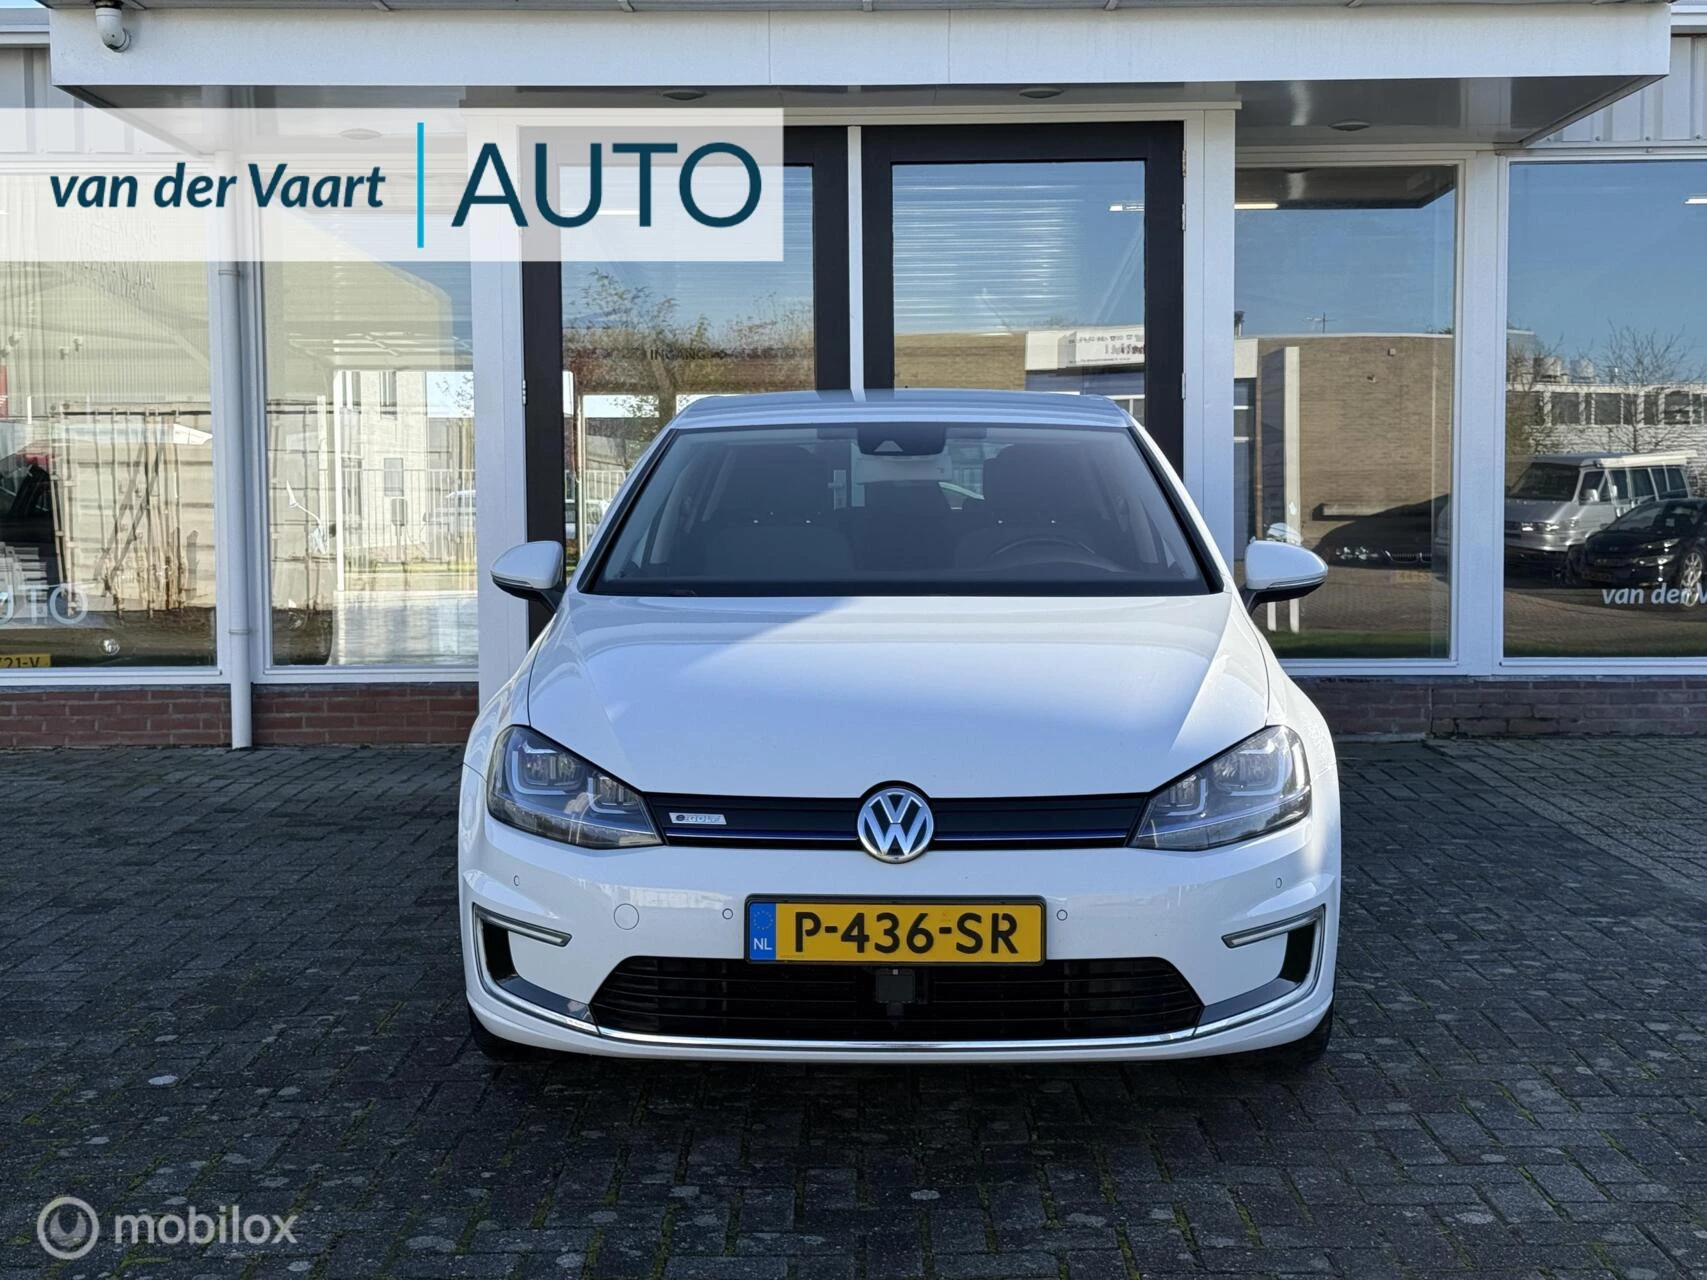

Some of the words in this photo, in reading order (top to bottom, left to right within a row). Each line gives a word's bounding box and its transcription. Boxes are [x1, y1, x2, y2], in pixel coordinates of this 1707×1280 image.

[650, 349, 706, 361] INGANG
[1601, 587, 1645, 605] van
[1651, 582, 1692, 605] der
[794, 911, 1019, 954] P-436-SR
[753, 937, 772, 950] NL
